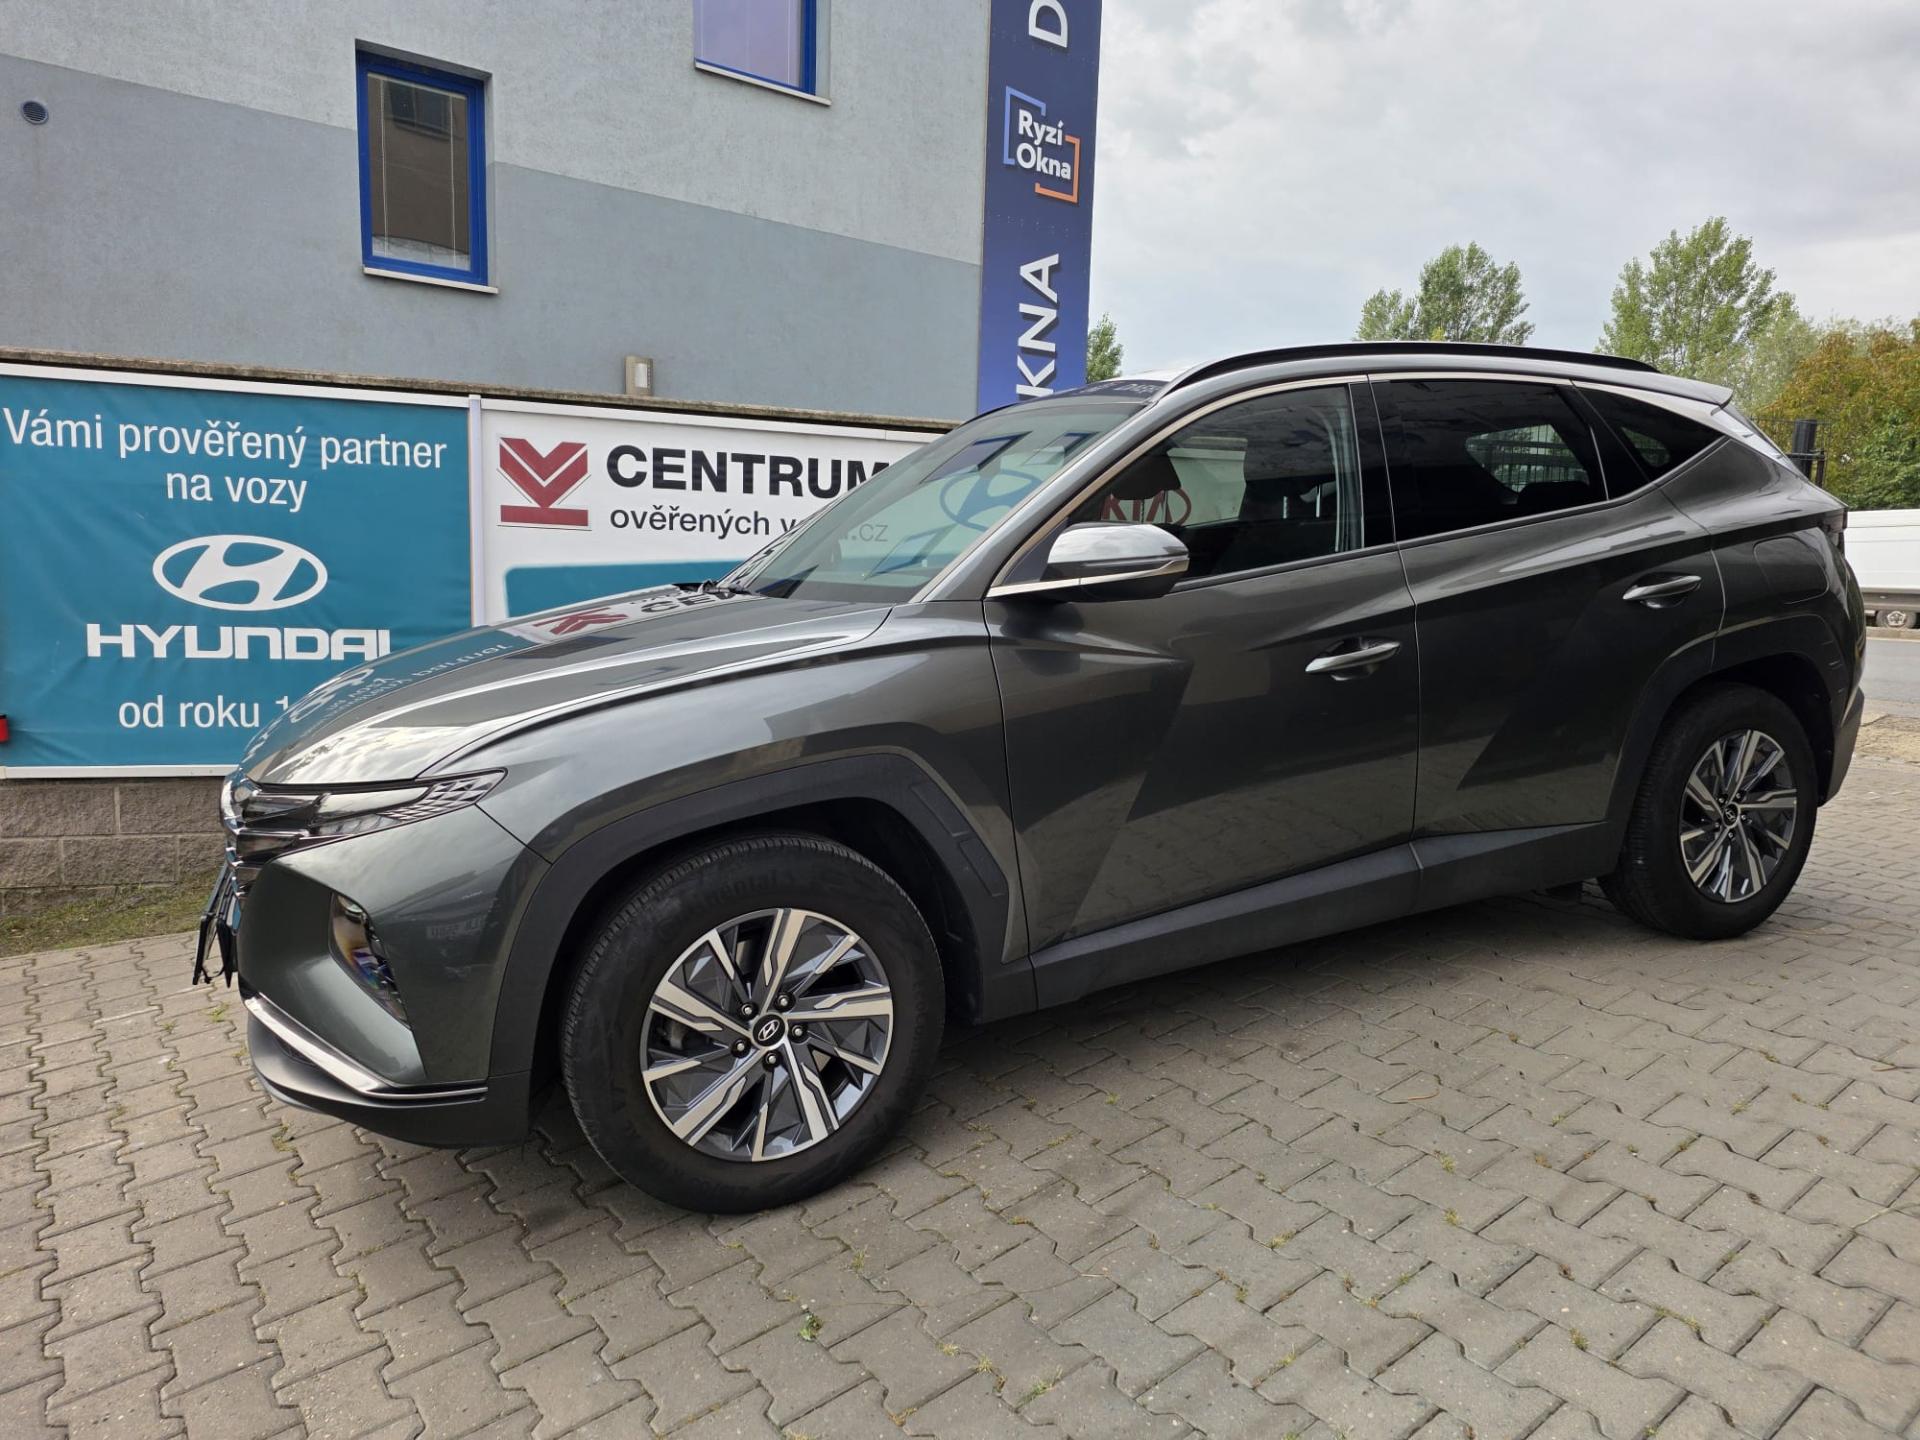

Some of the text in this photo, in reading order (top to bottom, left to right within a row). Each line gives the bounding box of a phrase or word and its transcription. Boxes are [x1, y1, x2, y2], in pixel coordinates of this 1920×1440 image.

[1018, 109, 1064, 146] Ryzí
[1016, 142, 1072, 180] Okna
[2, 407, 447, 470] Vámi prověřený partner
[166, 472, 308, 513] na vozy
[610, 504, 770, 540] ověřených
[86, 623, 391, 661] HYUNDAI
[118, 694, 164, 729] od
[179, 694, 260, 729] roku
